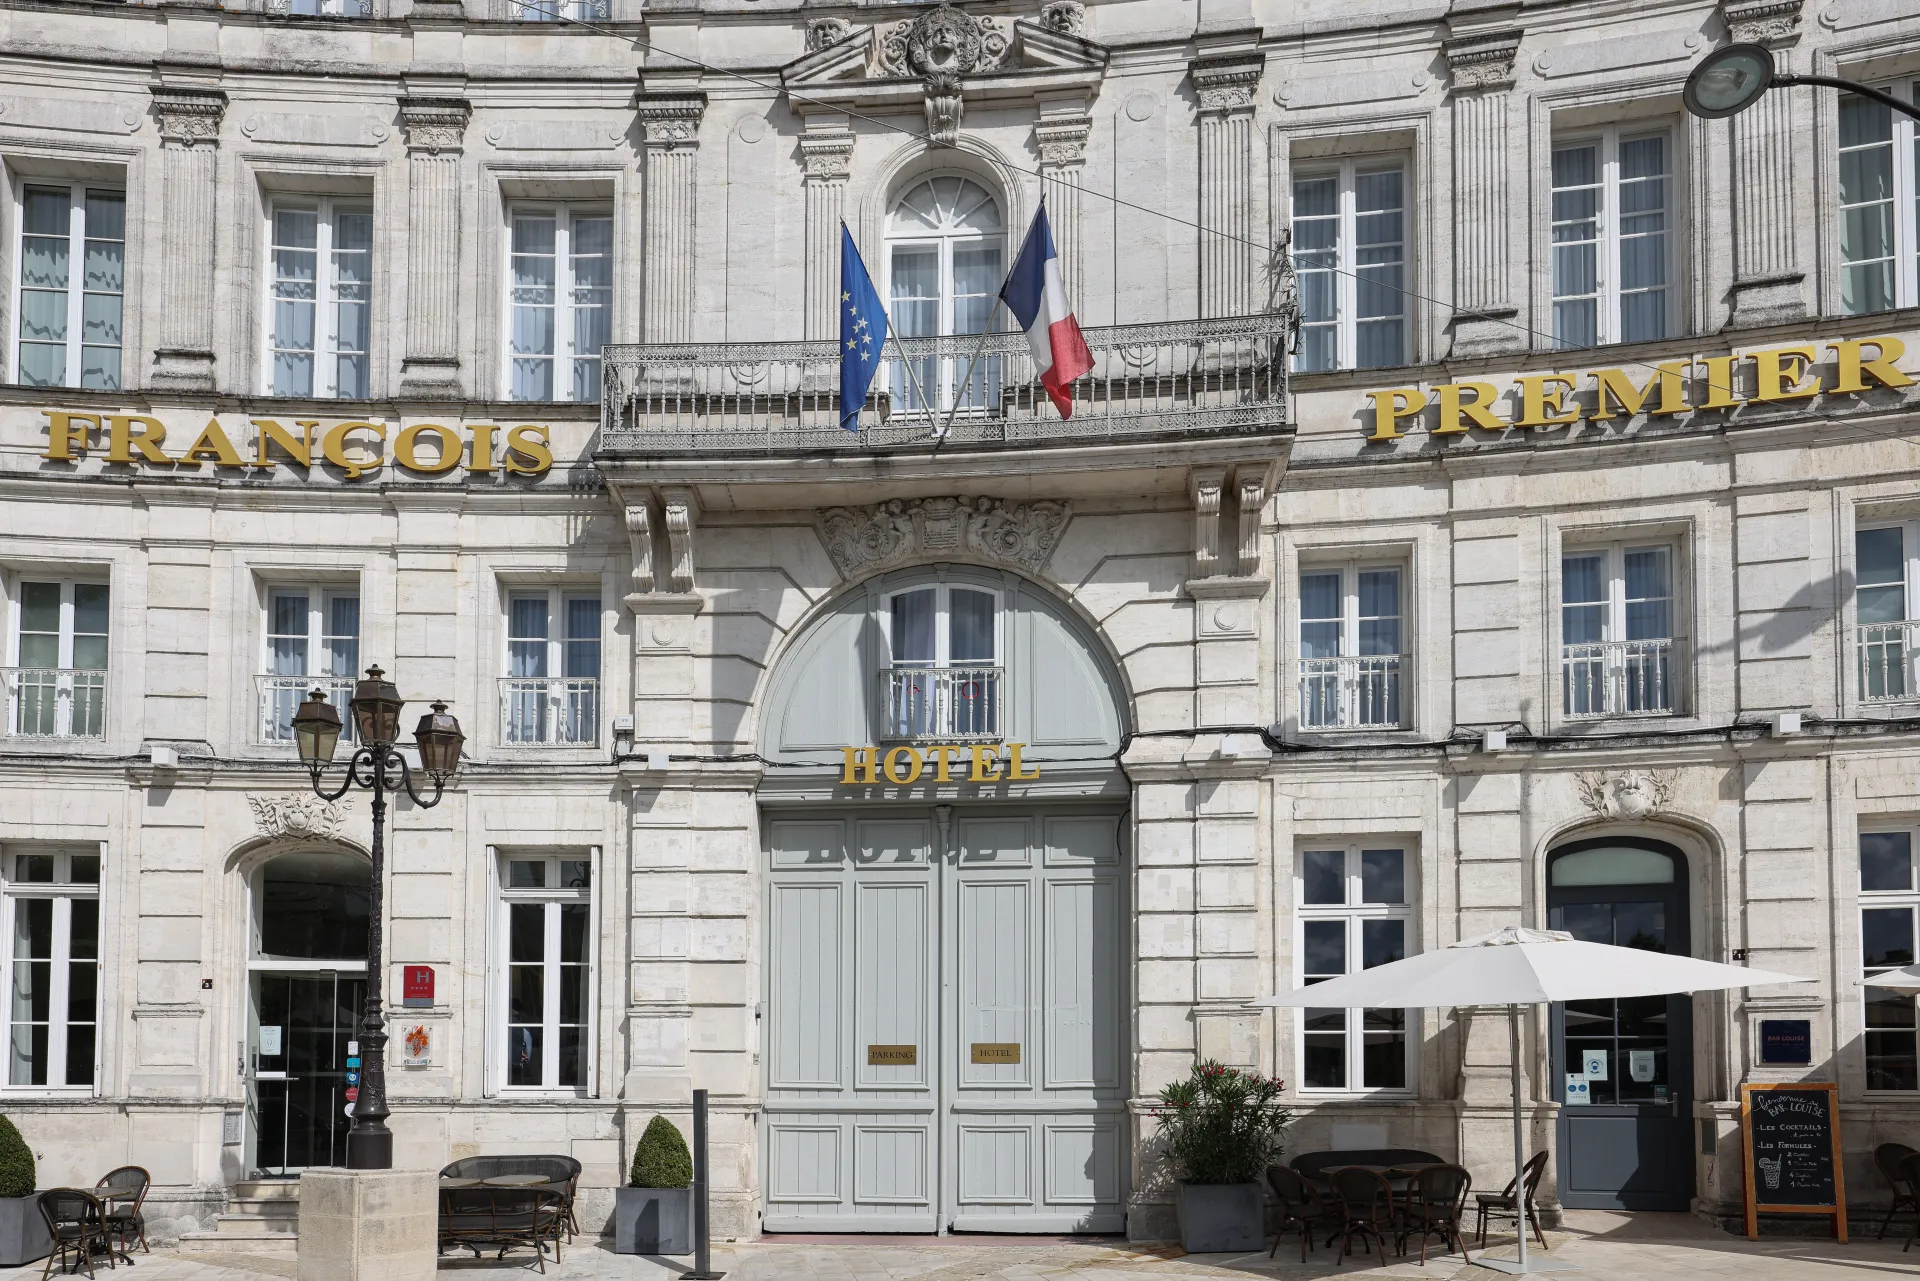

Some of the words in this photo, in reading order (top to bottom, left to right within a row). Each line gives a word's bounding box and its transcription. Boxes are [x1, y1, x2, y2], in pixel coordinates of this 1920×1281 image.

[1366, 337, 1919, 440] PREMIER
[39, 410, 554, 479] FRANÇOIS
[840, 743, 1041, 784] HOTEL
[416, 971, 430, 983] H
[872, 1051, 913, 1059] PARKING
[980, 1049, 1012, 1057] HOTEL
[1768, 1103, 1787, 1117] BAR
[1790, 1102, 1825, 1118] LOUISE
